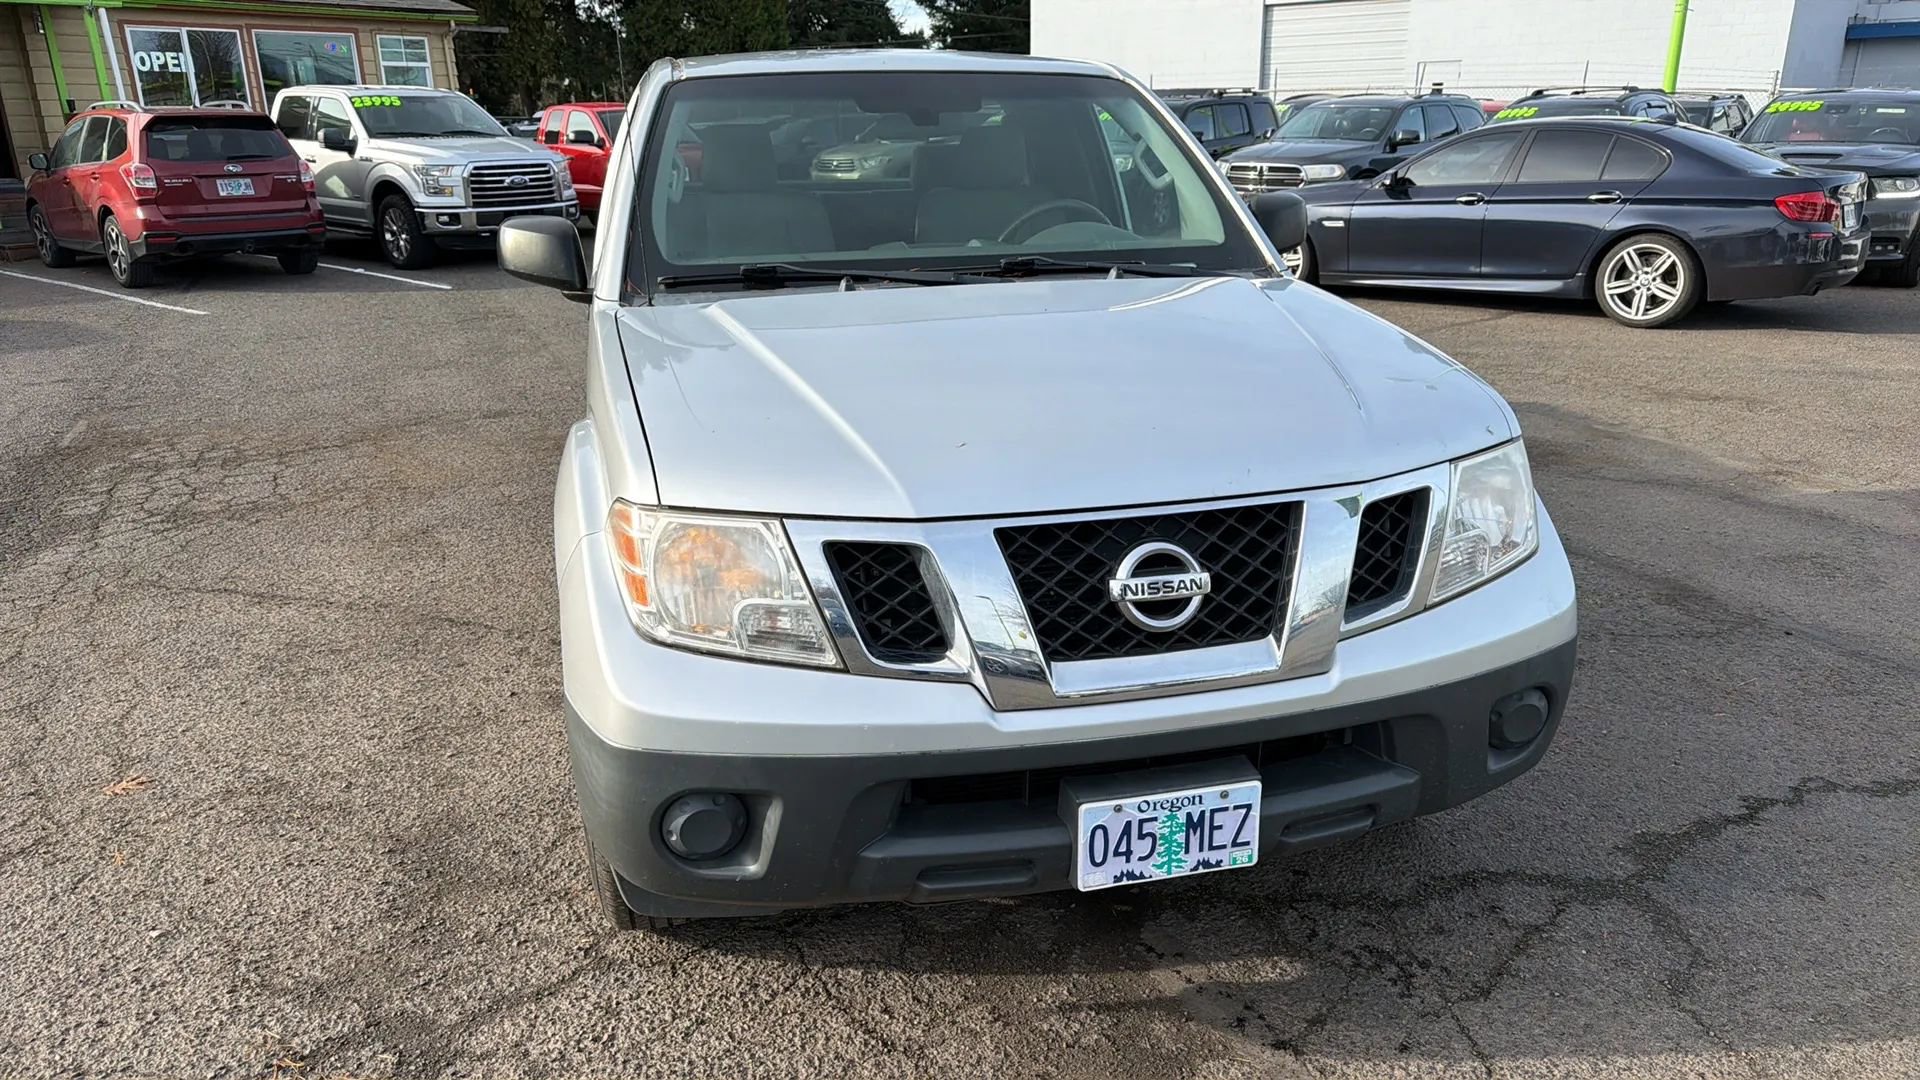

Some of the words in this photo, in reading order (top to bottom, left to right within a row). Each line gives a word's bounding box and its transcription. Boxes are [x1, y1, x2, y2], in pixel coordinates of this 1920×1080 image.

[351, 95, 402, 108] 23995
[1122, 577, 1203, 597] NISSAN
[1137, 794, 1204, 814] Oregon
[1088, 816, 1158, 867] 045
[1184, 803, 1253, 854] MEZ
[1235, 855, 1249, 864] 26
